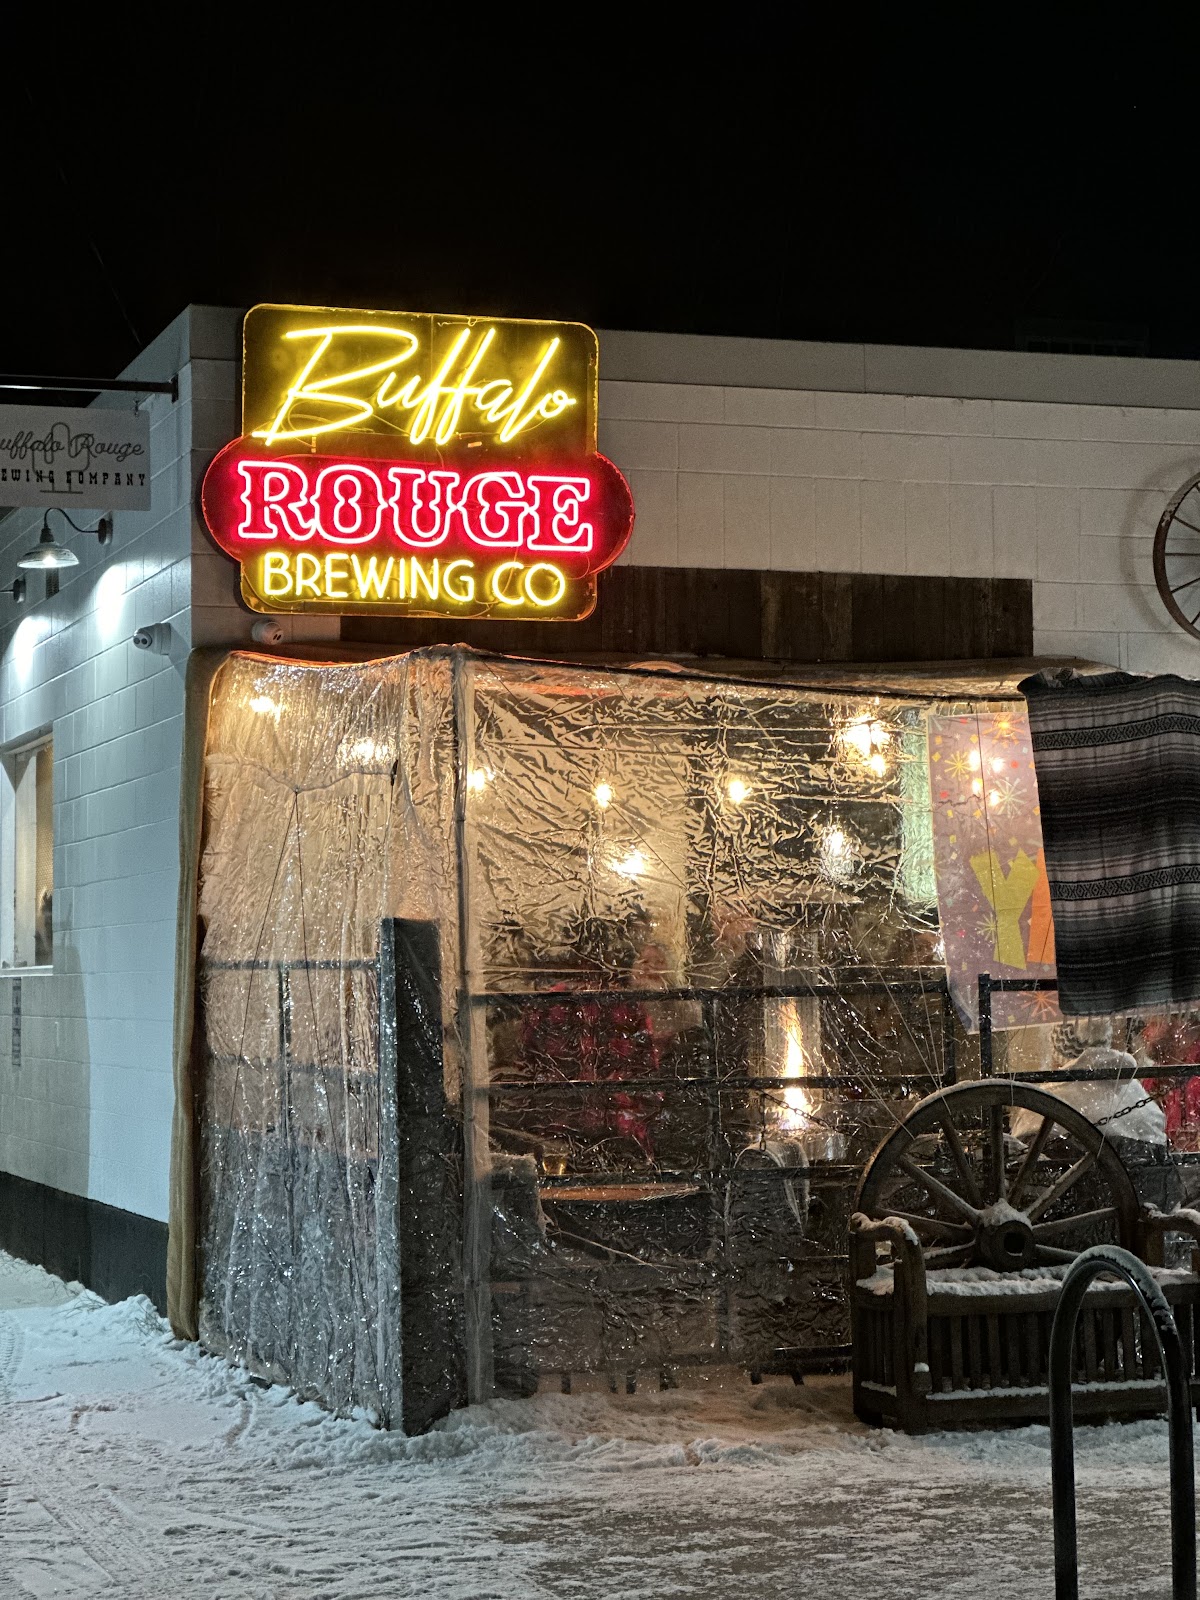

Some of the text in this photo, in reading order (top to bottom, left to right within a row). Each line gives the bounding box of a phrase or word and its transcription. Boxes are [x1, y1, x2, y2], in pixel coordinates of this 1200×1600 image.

[252, 325, 577, 446] Buffalo
[0, 431, 145, 462] uffalo Rouge
[1, 468, 146, 487] EWING COMPANY
[237, 460, 593, 552] ROUGE
[262, 551, 567, 607] BREWING CO
